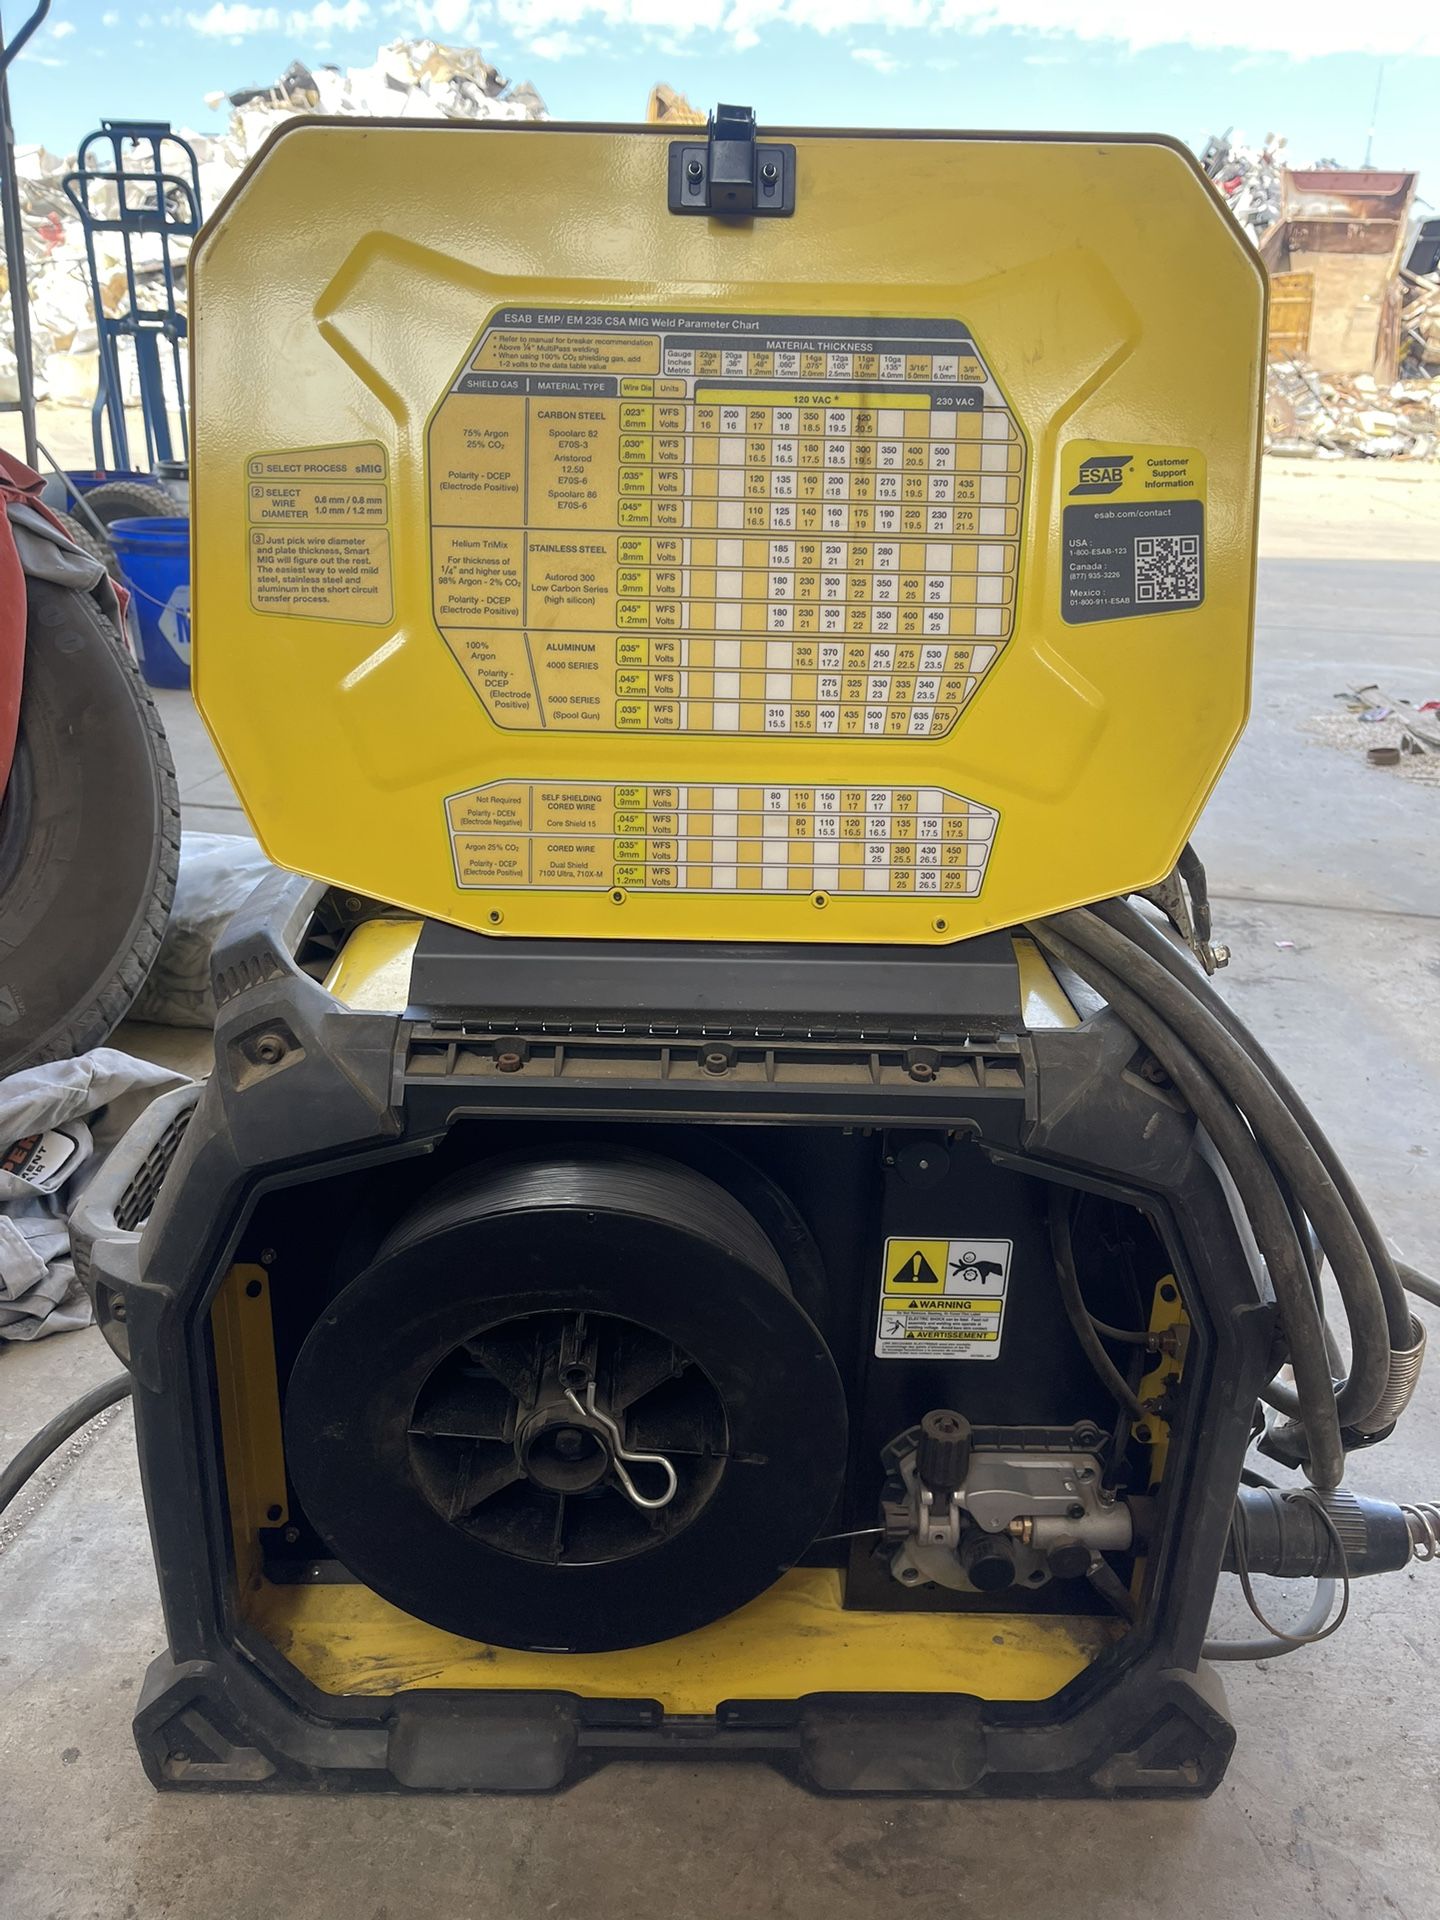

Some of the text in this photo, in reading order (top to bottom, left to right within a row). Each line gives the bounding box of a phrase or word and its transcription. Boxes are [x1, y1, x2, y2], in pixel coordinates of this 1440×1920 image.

[503, 313, 759, 329] ESAB EMP/ EM 235 CSA MIG Weld Parameter Chart
[767, 341, 872, 351] MATERIAL THICKNESS
[668, 350, 691, 358] Gauge
[831, 354, 849, 364] 12ga
[538, 411, 576, 419] CARBON
[777, 412, 792, 420] 300
[484, 430, 508, 439] Argon
[549, 429, 586, 438] Spoolarc
[253, 464, 260, 472] 1
[356, 464, 382, 473] sMIG
[1080, 469, 1122, 482] ESAB
[1152, 469, 1186, 478] Support
[558, 476, 587, 484] E70S-6
[440, 482, 518, 492] (Electrode Positive)
[253, 489, 261, 497] 2
[548, 490, 597, 499] Spoolarc 86
[558, 501, 587, 509] E70S-6
[1094, 509, 1171, 519] esab.com/contact
[254, 534, 262, 543] 3
[287, 537, 305, 545] pick
[275, 546, 296, 555] plate
[299, 547, 342, 555] thickness,
[529, 544, 577, 552] STAINLESS
[294, 556, 318, 565] figure
[545, 573, 578, 581] Autorod
[551, 584, 580, 592] Carbon
[584, 585, 608, 593] Series
[544, 596, 595, 605] (high silicon)
[568, 662, 598, 670] SERIES
[553, 711, 600, 720] (Spool Gun)
